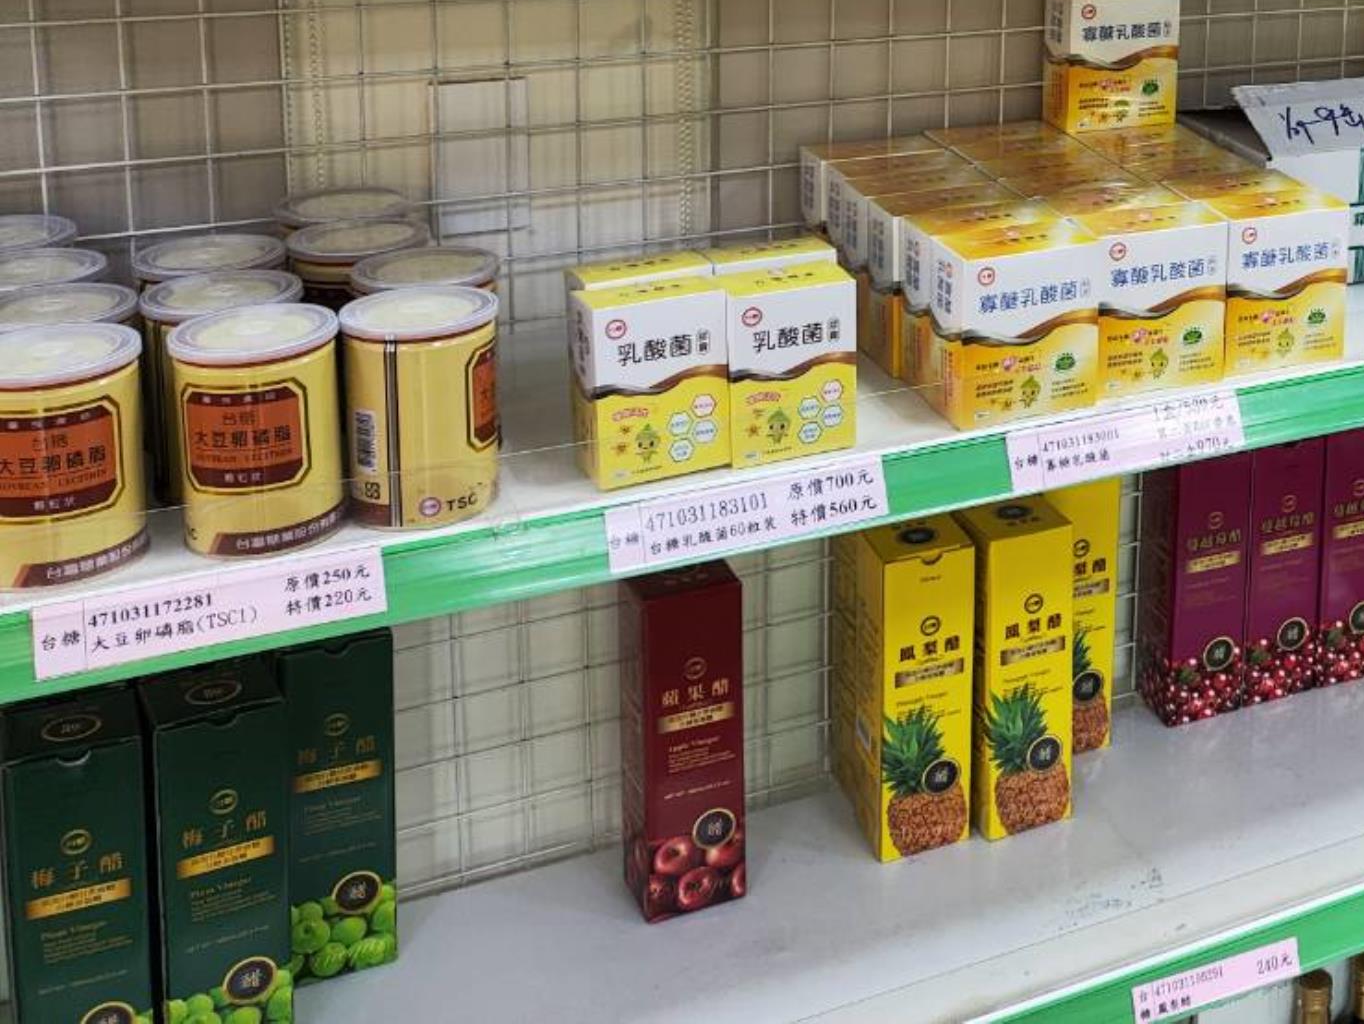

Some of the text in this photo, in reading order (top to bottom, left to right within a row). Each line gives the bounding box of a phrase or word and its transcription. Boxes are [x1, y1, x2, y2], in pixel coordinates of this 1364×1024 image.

[617, 333, 692, 367] 乳酸菌
[753, 322, 824, 354] 乳酸菌
[194, 425, 291, 449] 大豆卵磷脂
[446, 492, 477, 511] TSC
[646, 468, 875, 532] 471031183101 原價700元
[790, 494, 878, 527] 特價560元
[1073, 557, 1107, 575] 梨醋
[88, 564, 371, 628] 471031172281 原價250元
[285, 588, 373, 617] 特價220元
[41, 631, 82, 651] 台糖
[182, 810, 267, 848] 梅子醋
[33, 851, 124, 889] 梅子醋
[1256, 953, 1293, 975] 240元
